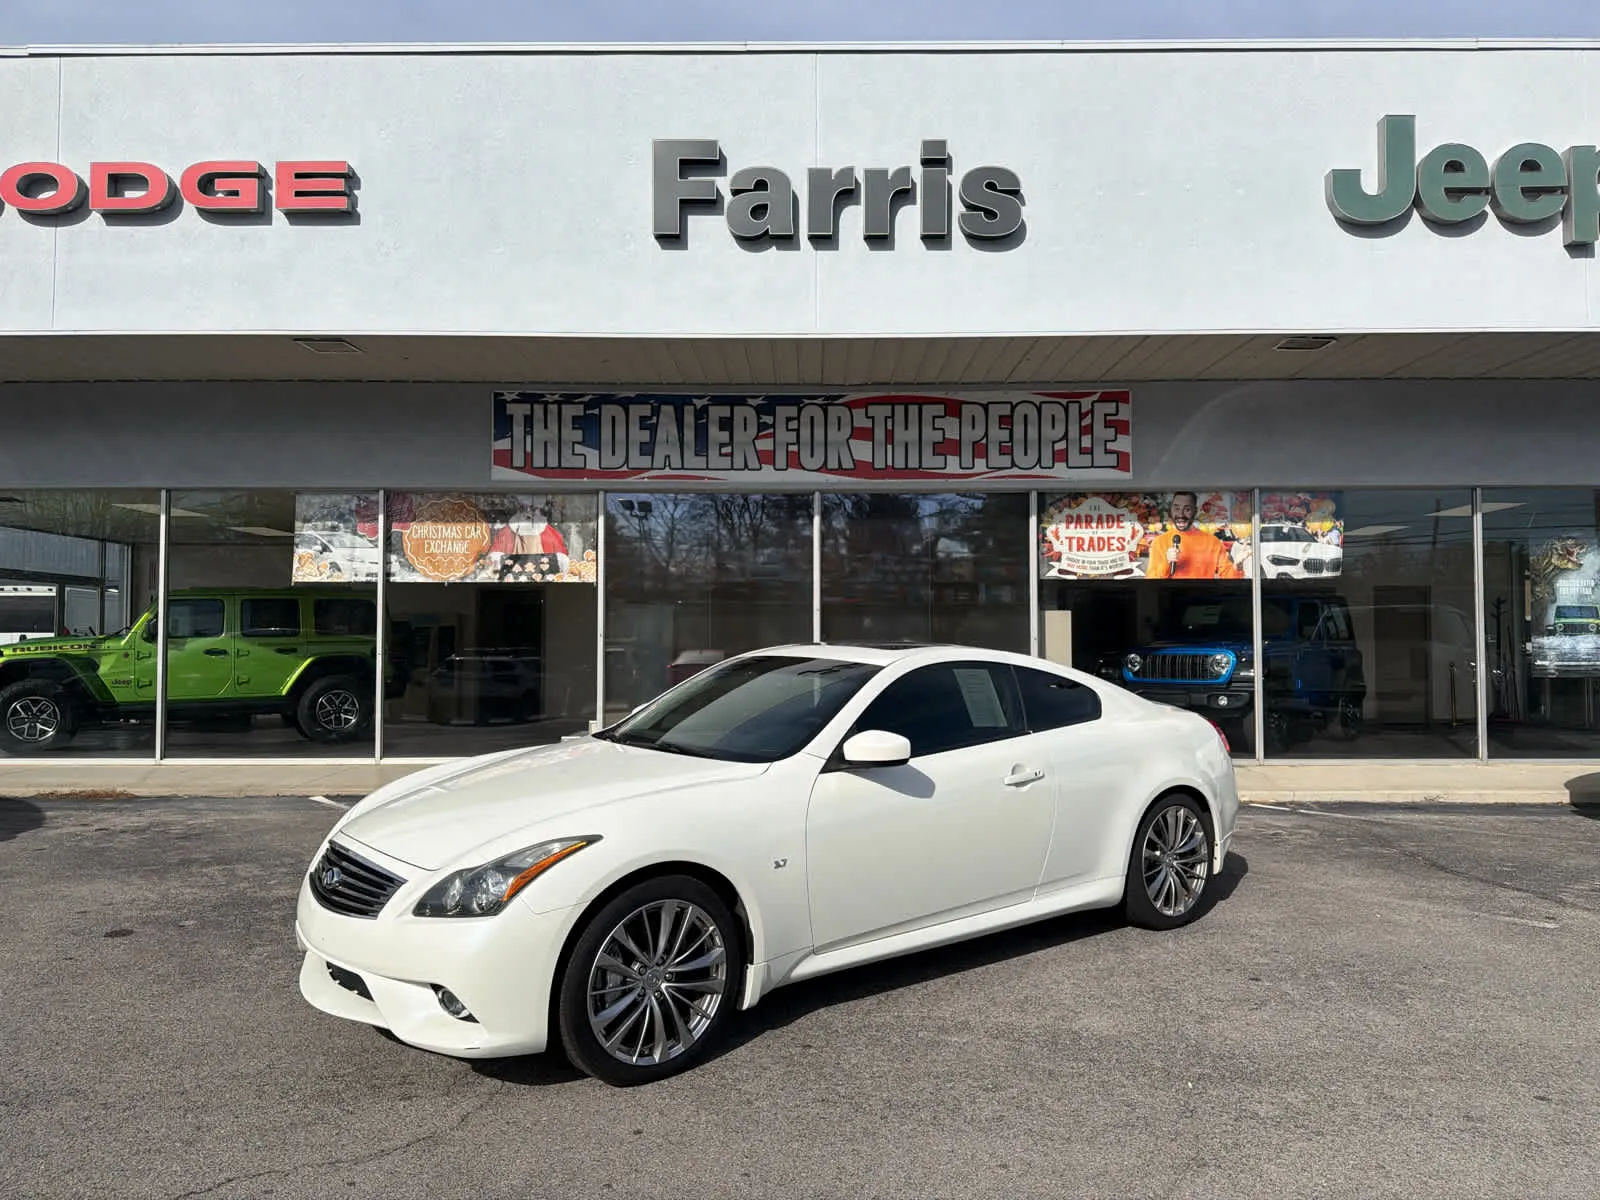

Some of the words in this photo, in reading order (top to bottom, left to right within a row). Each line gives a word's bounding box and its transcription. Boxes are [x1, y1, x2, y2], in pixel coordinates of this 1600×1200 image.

[0, 160, 352, 214] ODGE
[652, 138, 1024, 240] Farris
[505, 402, 587, 469] THE
[599, 402, 762, 470] DEALER
[774, 401, 855, 471] FOR
[866, 401, 947, 469] THE
[958, 400, 1119, 469] PEOPLE
[1064, 513, 1126, 530] PARADE
[411, 524, 462, 539] CHRISTMAS
[464, 525, 483, 539] CAR
[424, 541, 470, 554] EXCHANGE
[1064, 536, 1126, 552] TRADES
[12, 643, 98, 653] RUBICON
